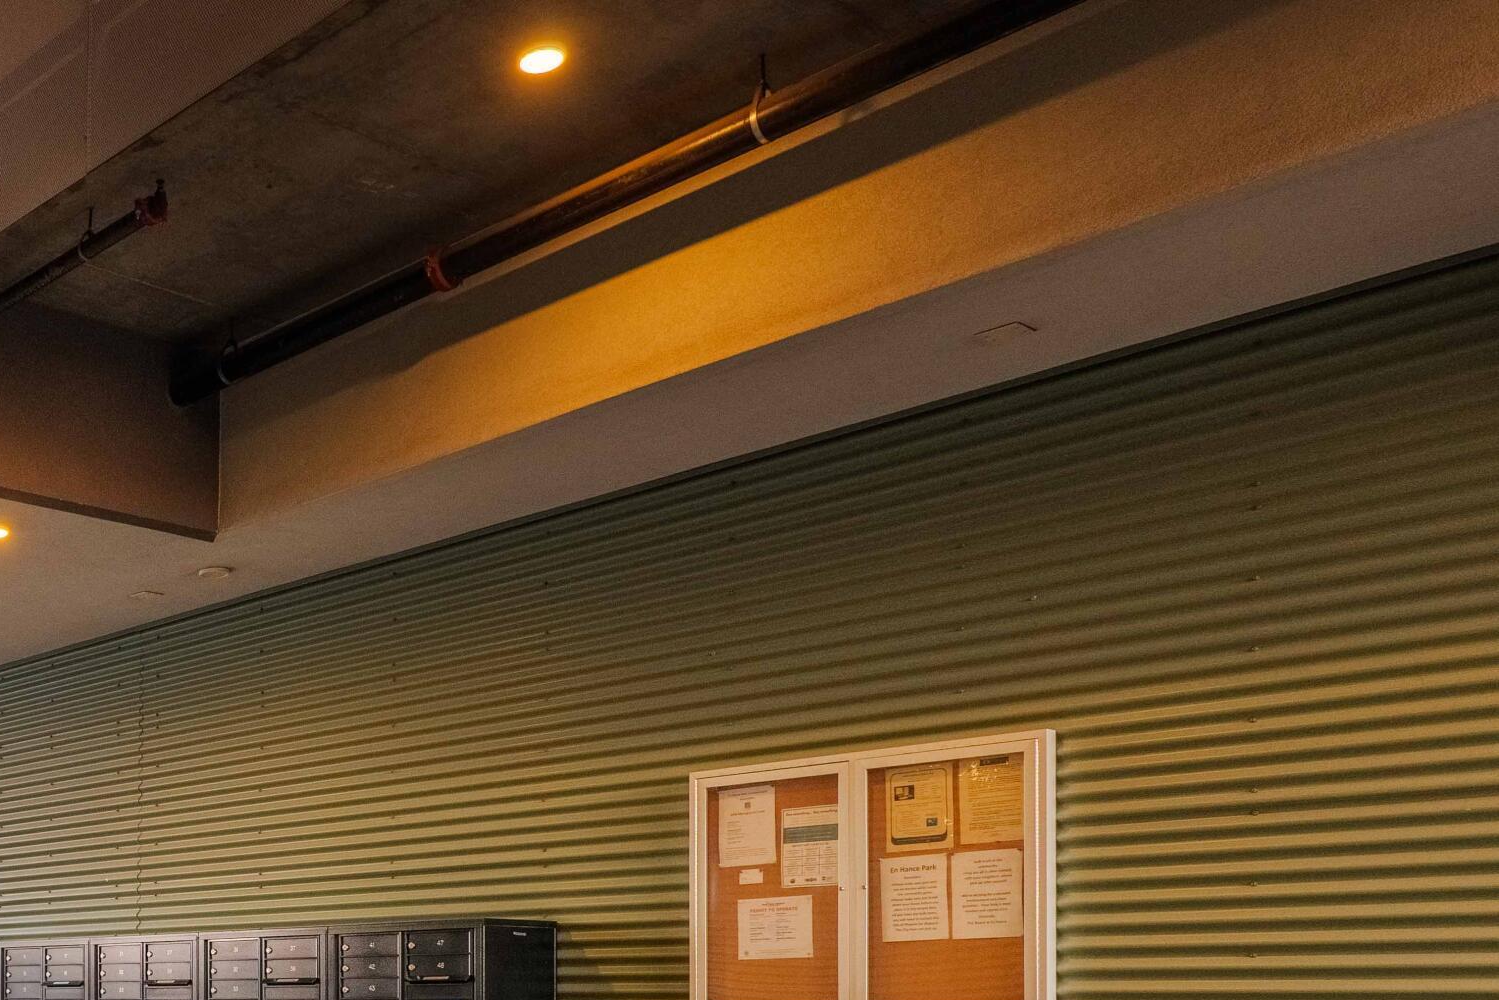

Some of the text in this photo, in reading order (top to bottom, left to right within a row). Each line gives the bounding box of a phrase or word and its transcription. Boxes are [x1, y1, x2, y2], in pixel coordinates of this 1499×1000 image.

[890, 863, 937, 874] En Hance Park
